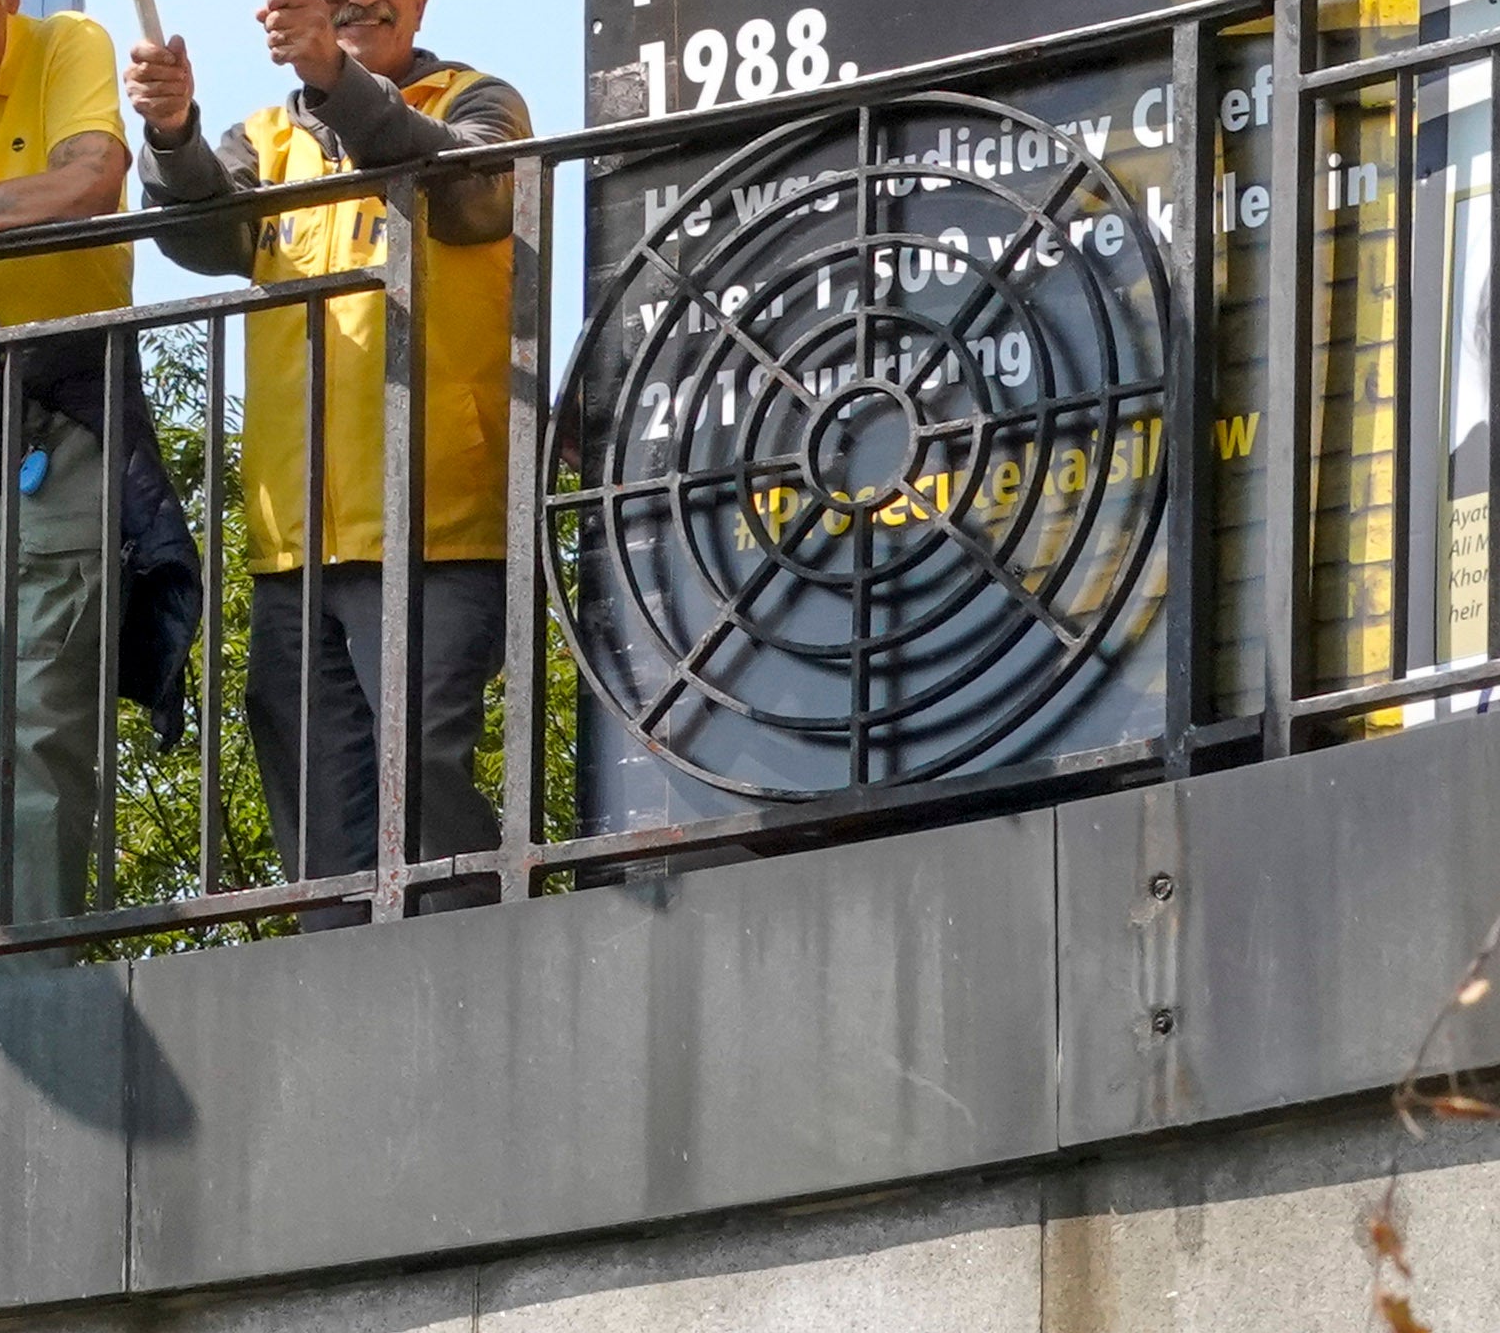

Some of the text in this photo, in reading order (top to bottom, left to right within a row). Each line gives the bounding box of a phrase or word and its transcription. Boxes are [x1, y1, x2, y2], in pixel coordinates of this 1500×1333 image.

[638, 7, 859, 121] 1988.
[874, 113, 1113, 199] udiciary
[1131, 63, 1273, 149] Cef
[1326, 151, 1378, 212] in
[1449, 536, 1473, 560] Ali
[1449, 599, 1483, 624] heir
